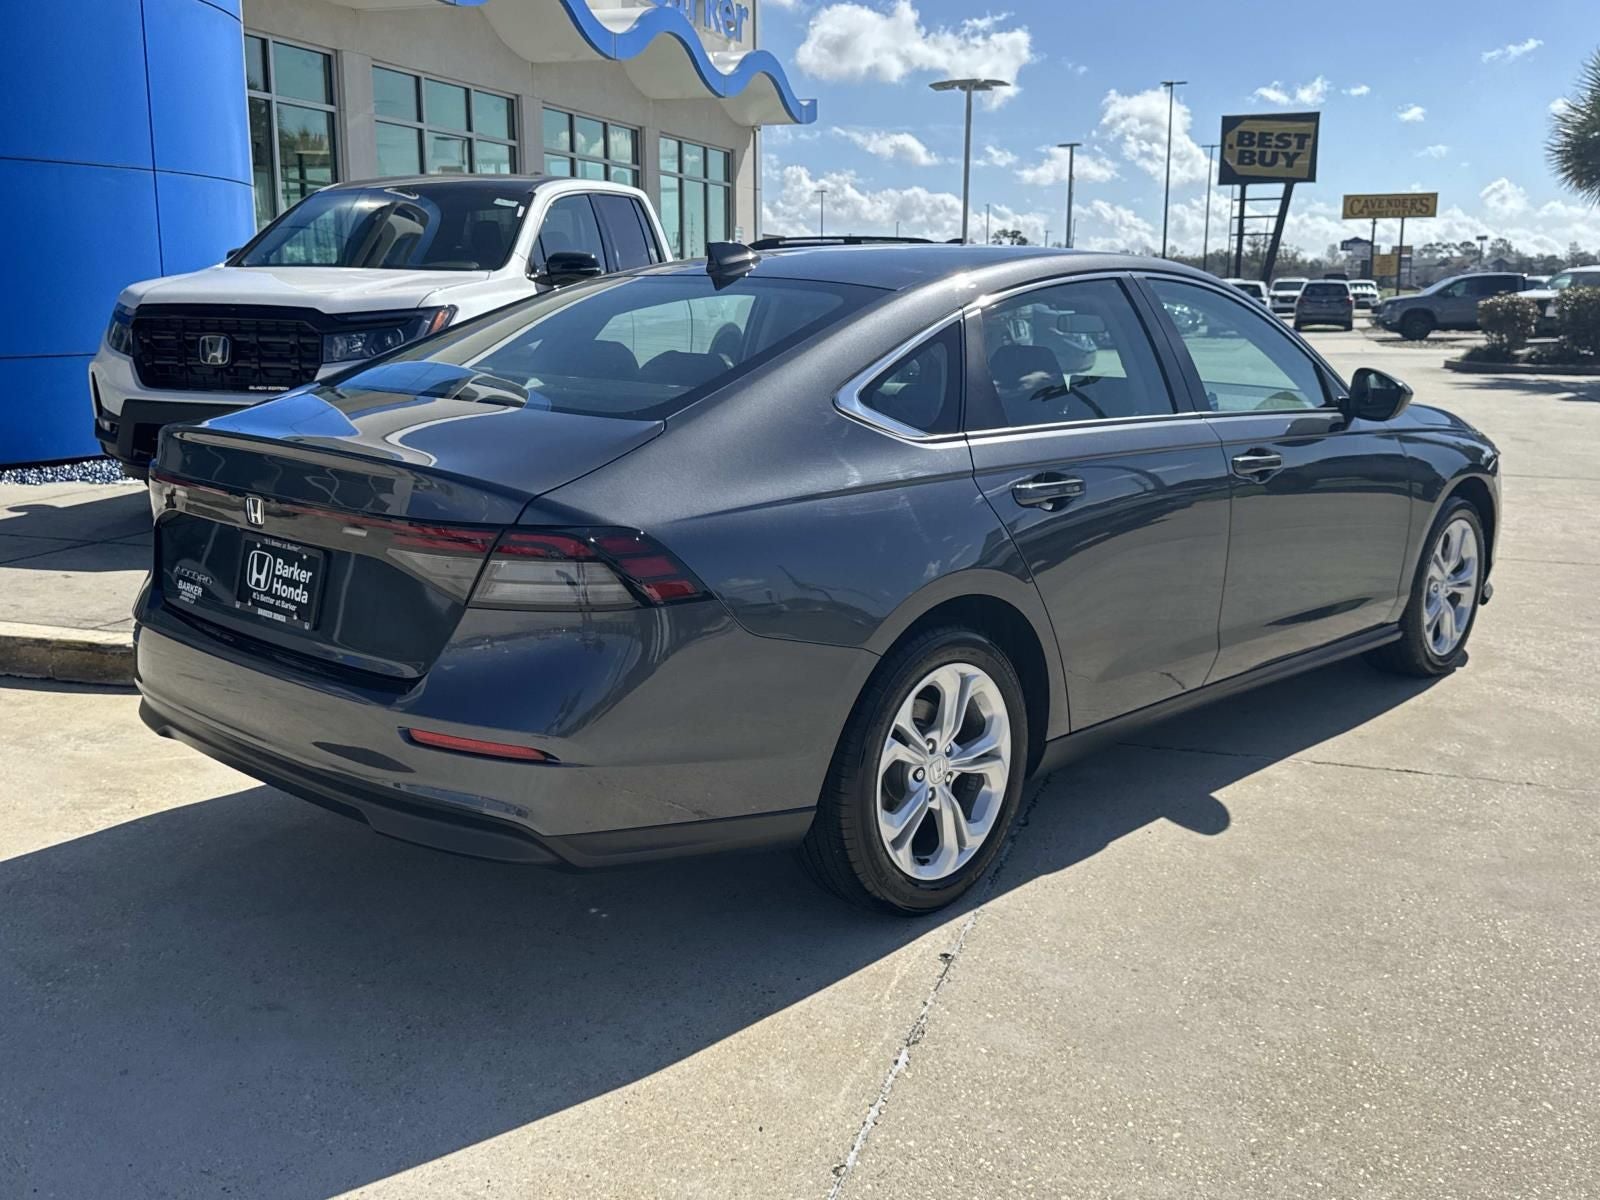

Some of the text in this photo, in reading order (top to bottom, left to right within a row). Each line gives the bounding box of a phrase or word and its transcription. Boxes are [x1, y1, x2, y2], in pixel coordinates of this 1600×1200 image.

[1236, 131, 1311, 150] BEST
[1237, 149, 1302, 168] BUY
[275, 557, 312, 584] Barker
[178, 579, 203, 597] BARKER
[272, 577, 308, 604] Honda
